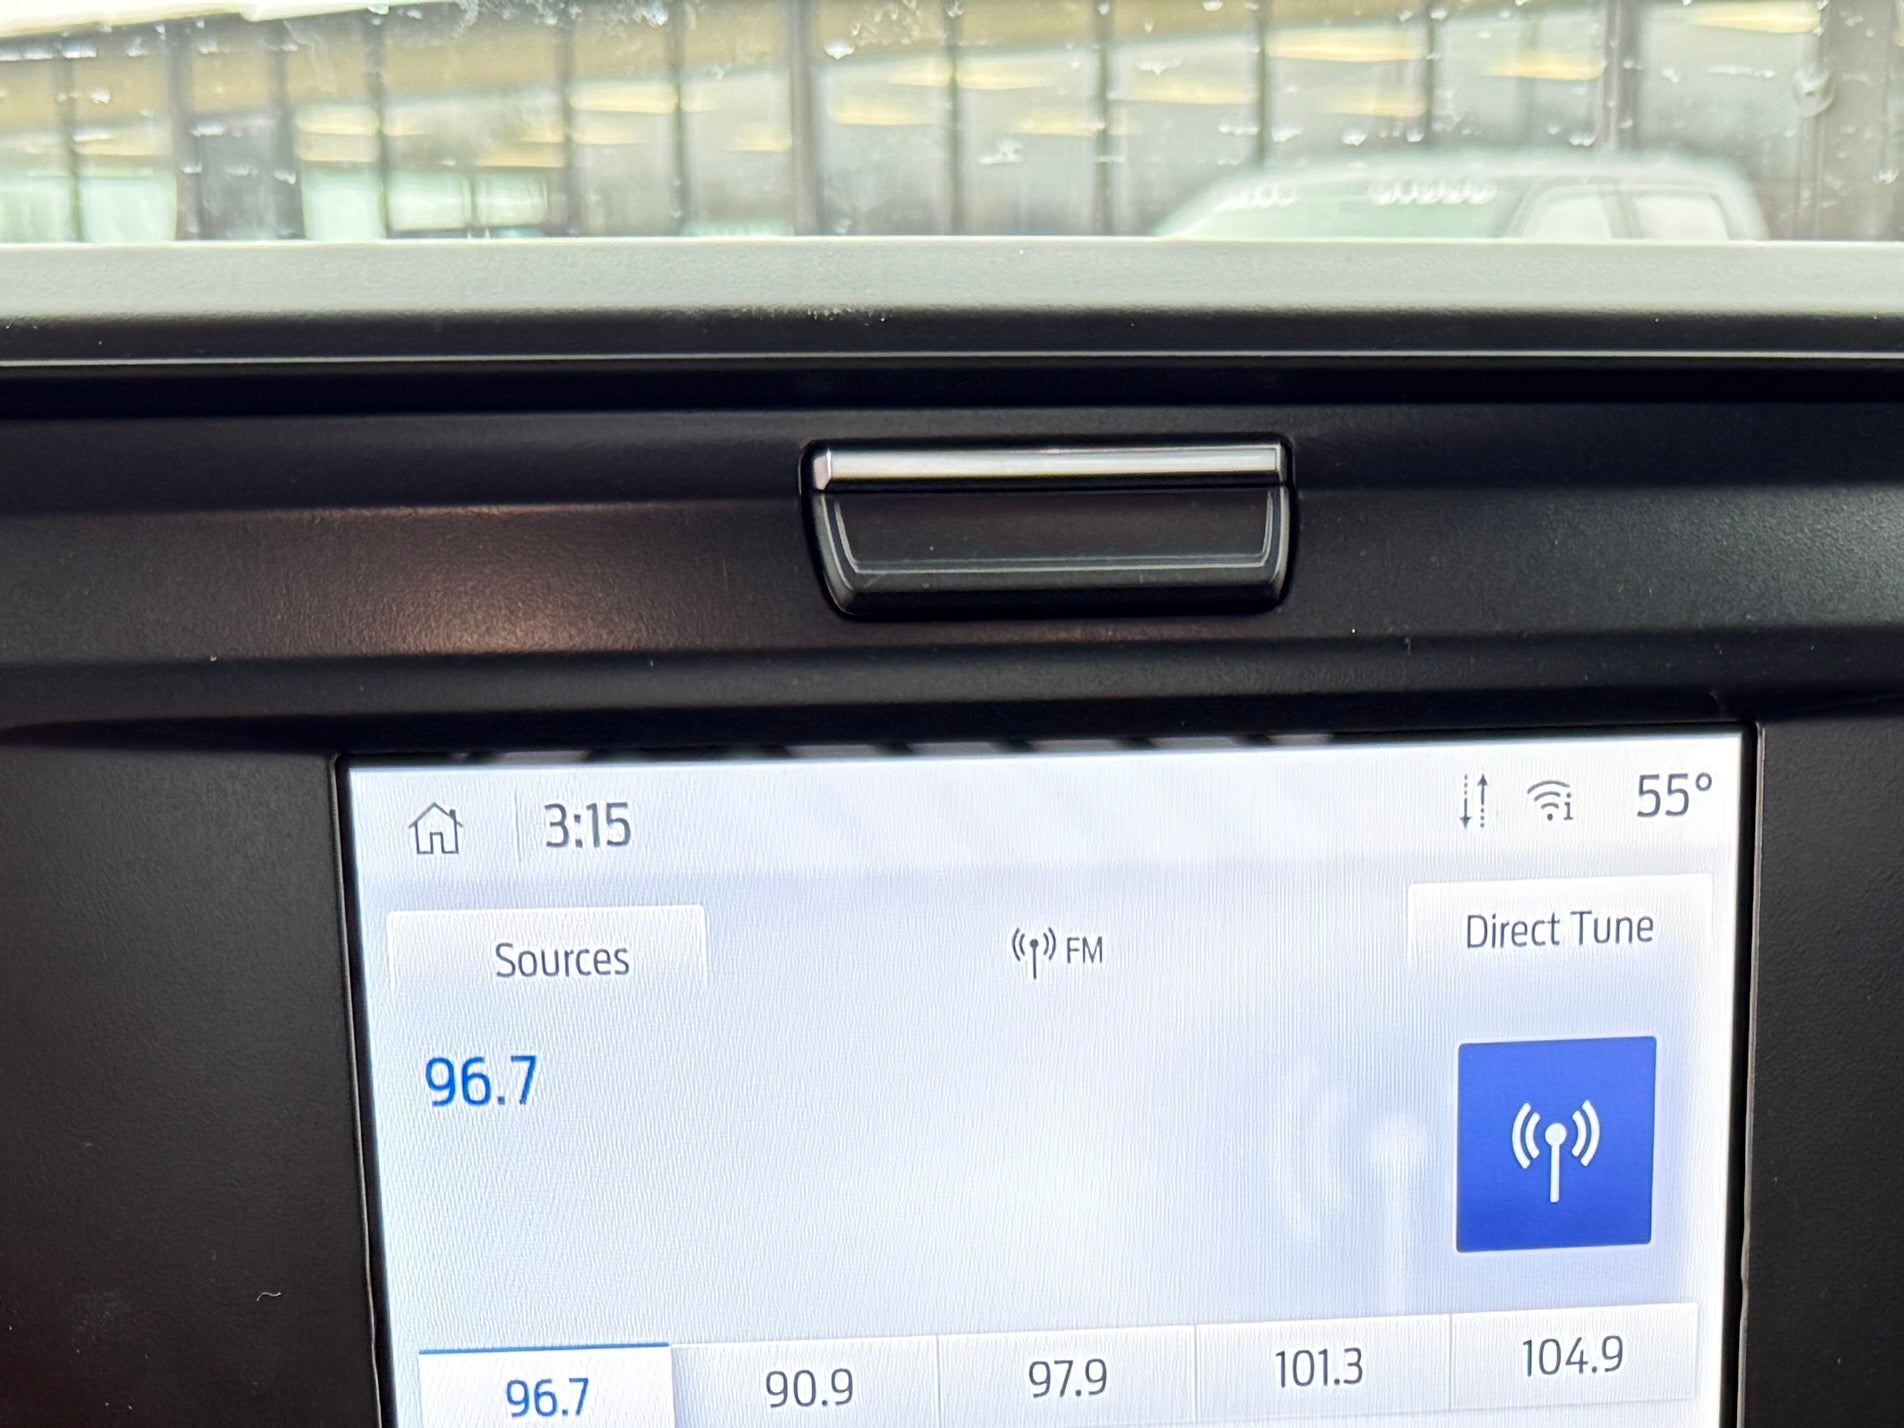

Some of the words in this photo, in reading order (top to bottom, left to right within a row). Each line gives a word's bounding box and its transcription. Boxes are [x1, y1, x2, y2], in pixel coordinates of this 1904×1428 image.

[1636, 771, 1713, 818] 55°
[544, 801, 632, 849] 3:15
[1466, 912, 1561, 950] Direct
[1571, 909, 1655, 945] Tune
[495, 941, 631, 979] Sources
[1066, 937, 1104, 965] FM
[424, 1054, 538, 1107] 96.7
[1274, 1346, 1365, 1389] 101.3
[1522, 1334, 1624, 1377] 104.9
[505, 1377, 590, 1418] 96.7
[765, 1367, 855, 1409] 90.9
[1028, 1358, 1108, 1399] 97.9
